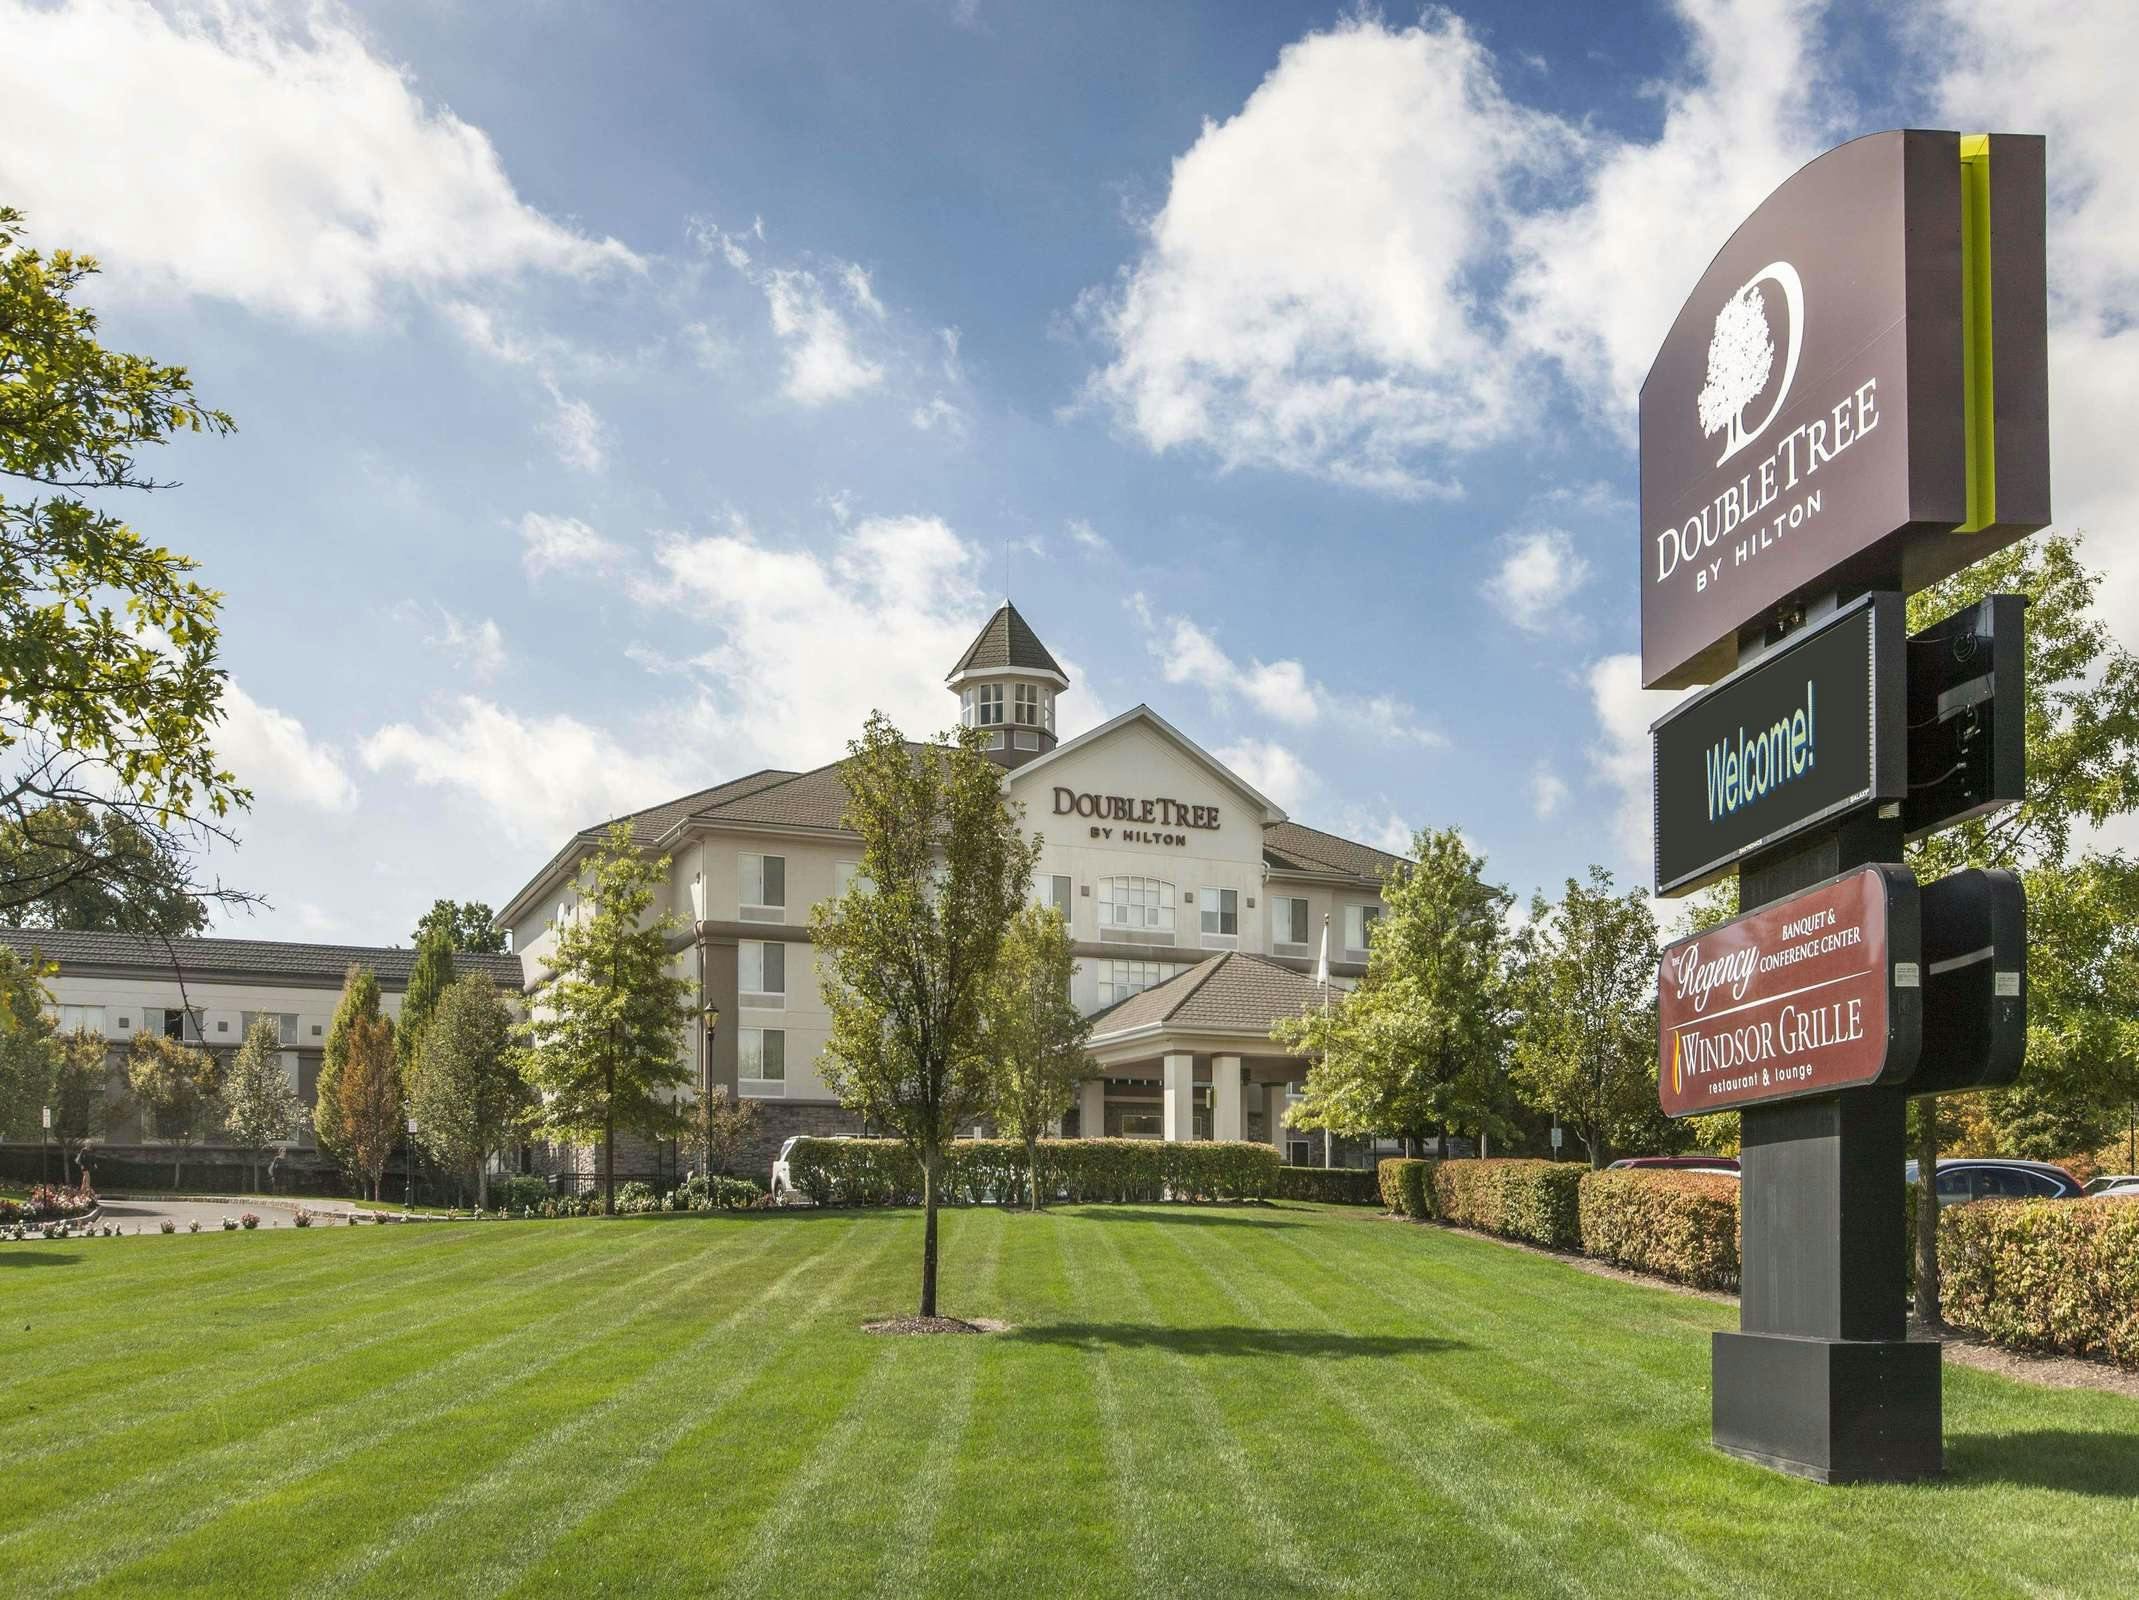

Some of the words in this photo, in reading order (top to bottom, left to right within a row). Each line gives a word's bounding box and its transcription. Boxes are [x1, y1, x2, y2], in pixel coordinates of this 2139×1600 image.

[1696, 557, 1722, 593] BY
[1735, 489, 1822, 567] HILTON
[1706, 680, 1816, 821] Welcome!
[1090, 826, 1113, 840] BY
[1123, 830, 1187, 847] HILTON
[1760, 939, 1820, 973] CONFERENCE
[1820, 926, 1862, 953] CENTER
[1782, 911, 1827, 941] BANQUET
[1827, 907, 1836, 925] &
[1677, 942, 1760, 1013] Regency
[1682, 1021, 1777, 1077] WINDSOR
[1779, 998, 1864, 1055] GRILLE
[1709, 1072, 1758, 1095] restaurant
[1762, 1067, 1770, 1087] &
[1775, 1062, 1813, 1081] lounge
